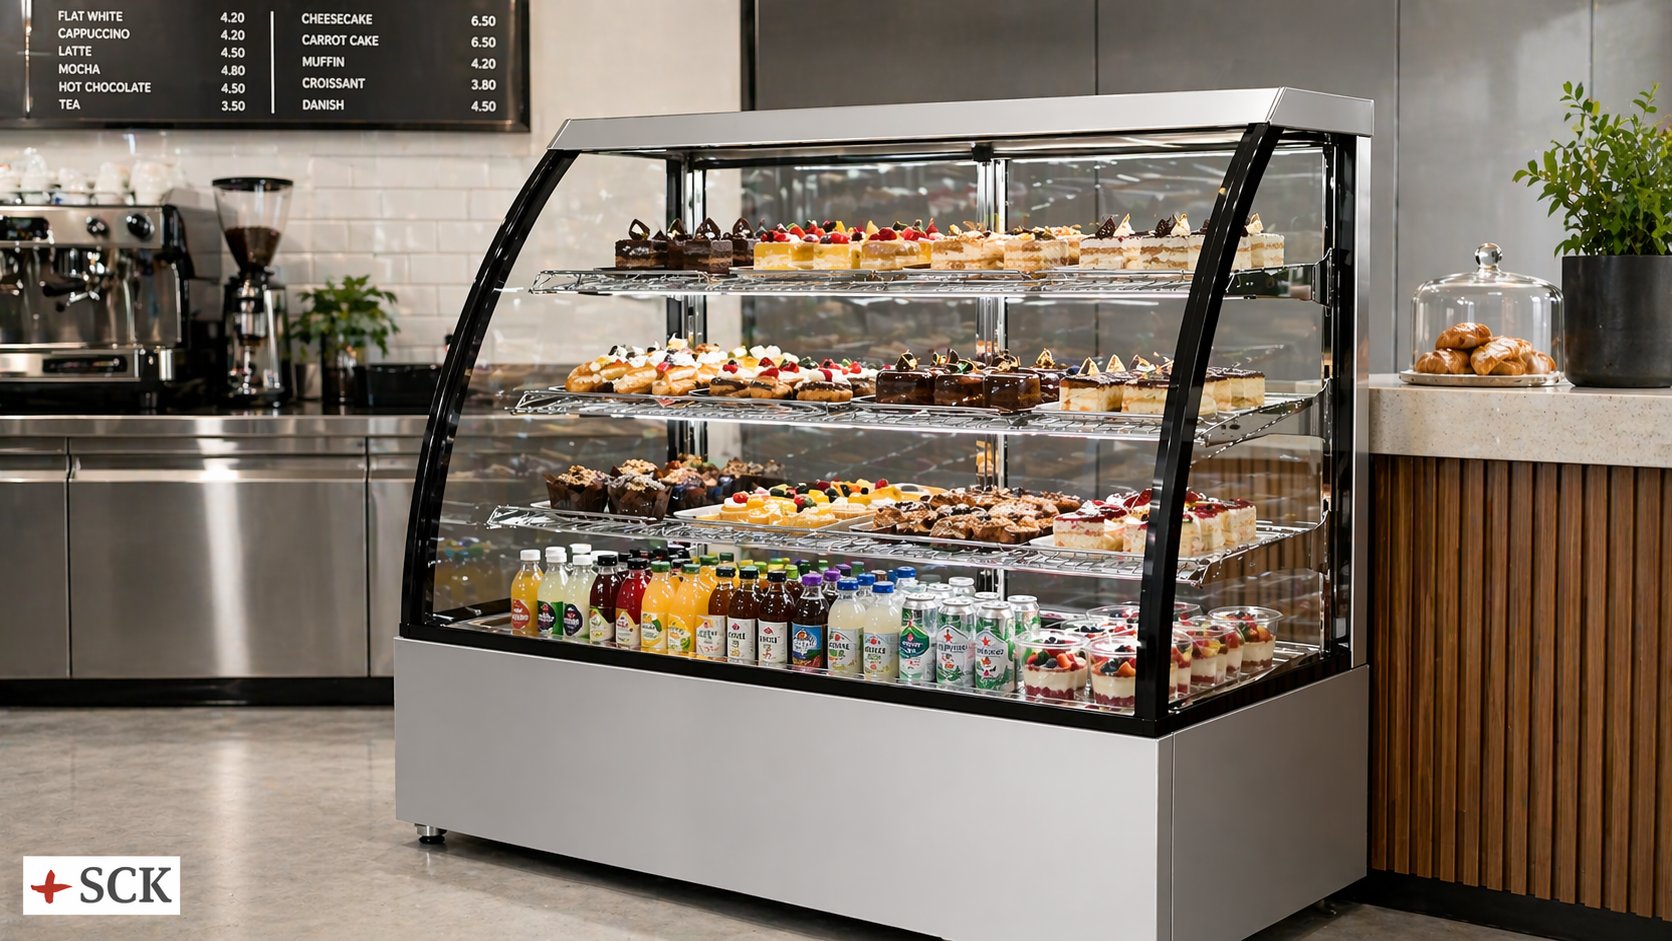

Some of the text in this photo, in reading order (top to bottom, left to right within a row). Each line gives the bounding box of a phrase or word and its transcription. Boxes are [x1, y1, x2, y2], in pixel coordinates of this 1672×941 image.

[57, 10, 123, 23] FLAT WHITE
[220, 12, 245, 24] 4.20
[301, 13, 373, 25] CHEESECAKE
[470, 15, 497, 27] 6.50
[57, 28, 130, 40] CAPPUCCINO
[220, 29, 245, 41] 4.20
[301, 35, 379, 47] CARROT CAKE
[470, 36, 497, 48] 6.50
[58, 45, 92, 57] LATTE
[220, 47, 246, 59] 4.50
[302, 56, 345, 68] MUFFIN
[470, 58, 497, 70] 4.20
[58, 63, 101, 75] MOCHA
[220, 65, 246, 76] 4.80
[58, 81, 152, 93] HOT CHOCOLATE
[220, 83, 246, 94] 4.50
[302, 77, 366, 89] CROISSANT
[471, 78, 497, 91] 3.80
[58, 98, 81, 110] TEA
[221, 100, 246, 112] 3.50
[302, 99, 345, 110] DANISH
[471, 100, 497, 112] 4.50
